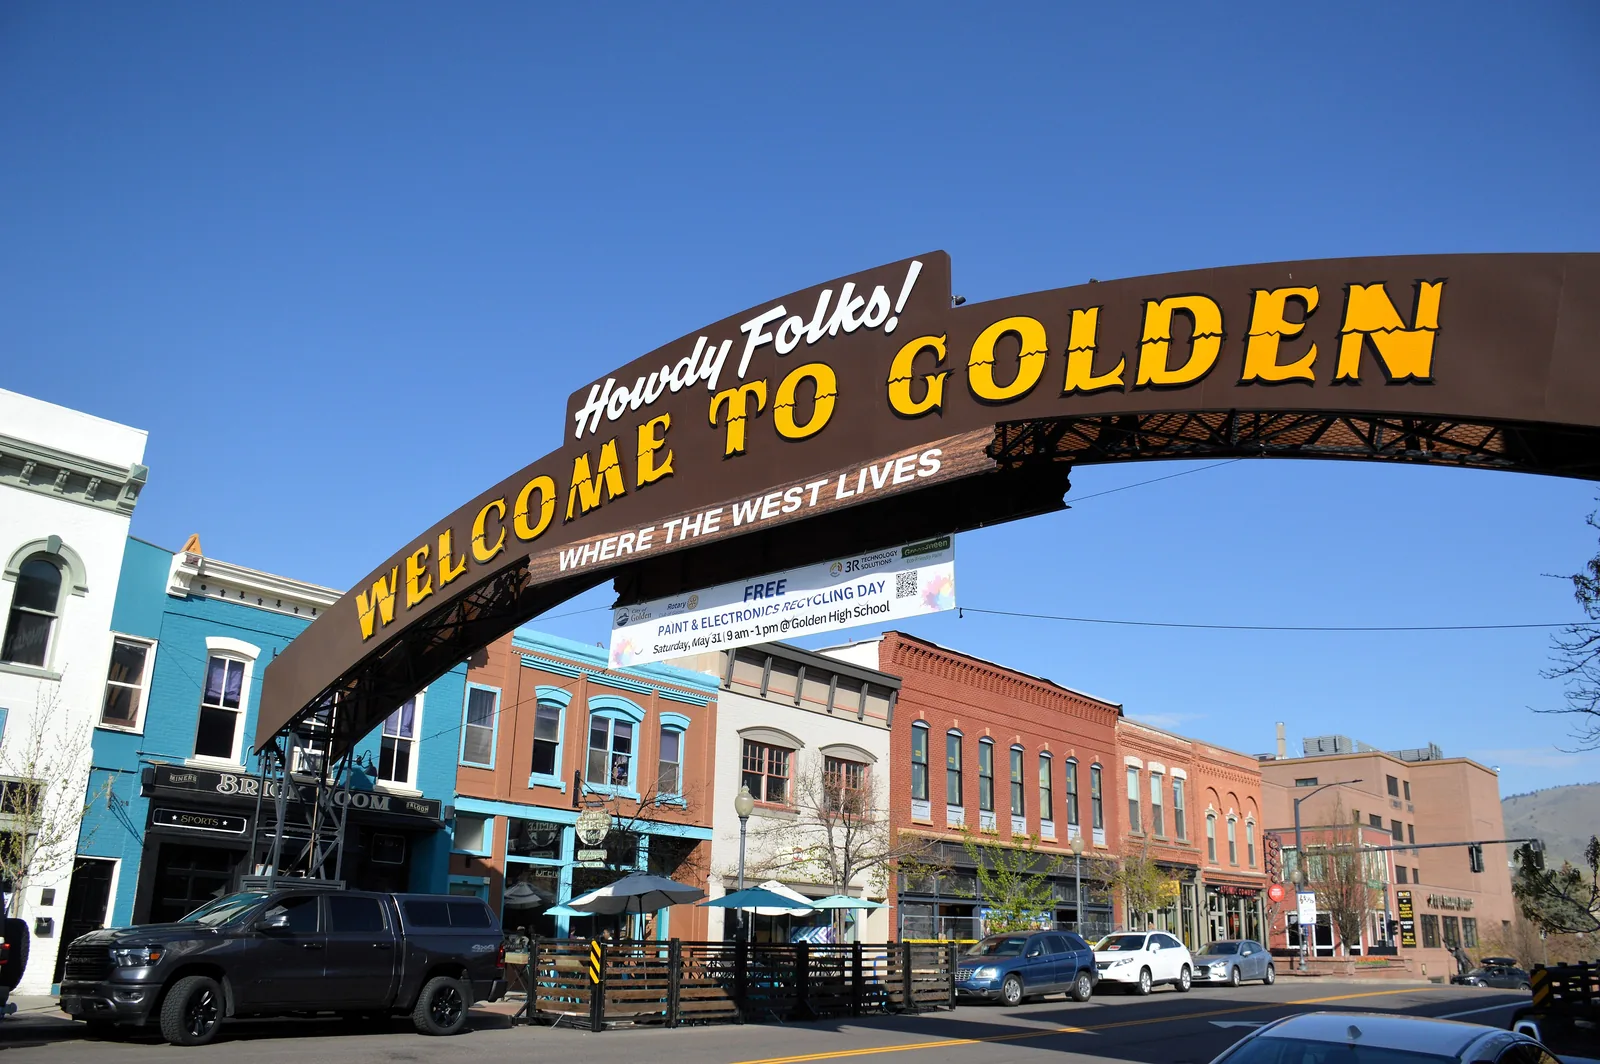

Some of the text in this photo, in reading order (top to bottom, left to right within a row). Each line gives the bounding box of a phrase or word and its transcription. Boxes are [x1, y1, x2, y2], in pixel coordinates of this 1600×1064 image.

[575, 260, 923, 439] Howdy Folks!
[355, 277, 1447, 642] WELCOME TO GOLDEN
[559, 448, 942, 572] WHERE THE WEST LIVES
[861, 550, 898, 563] TECHNOLOGY
[845, 560, 860, 573] 3R
[861, 558, 892, 570] SOLUTIONS
[743, 579, 787, 602] FREE
[631, 607, 642, 615] City
[658, 580, 886, 636] PAINT & ELECTRONICS RECYCLING DAY
[667, 601, 687, 611] Rotary
[631, 612, 652, 622] Golden
[653, 640, 691, 655] Saturday,
[691, 636, 710, 648] May
[711, 632, 721, 643] 31
[780, 619, 790, 632] @
[791, 615, 827, 629] Golden
[828, 607, 852, 622] High
[853, 600, 890, 619] School
[169, 773, 198, 784] MINERS
[406, 801, 430, 814] SALOON
[181, 814, 219, 826] SPORTS
